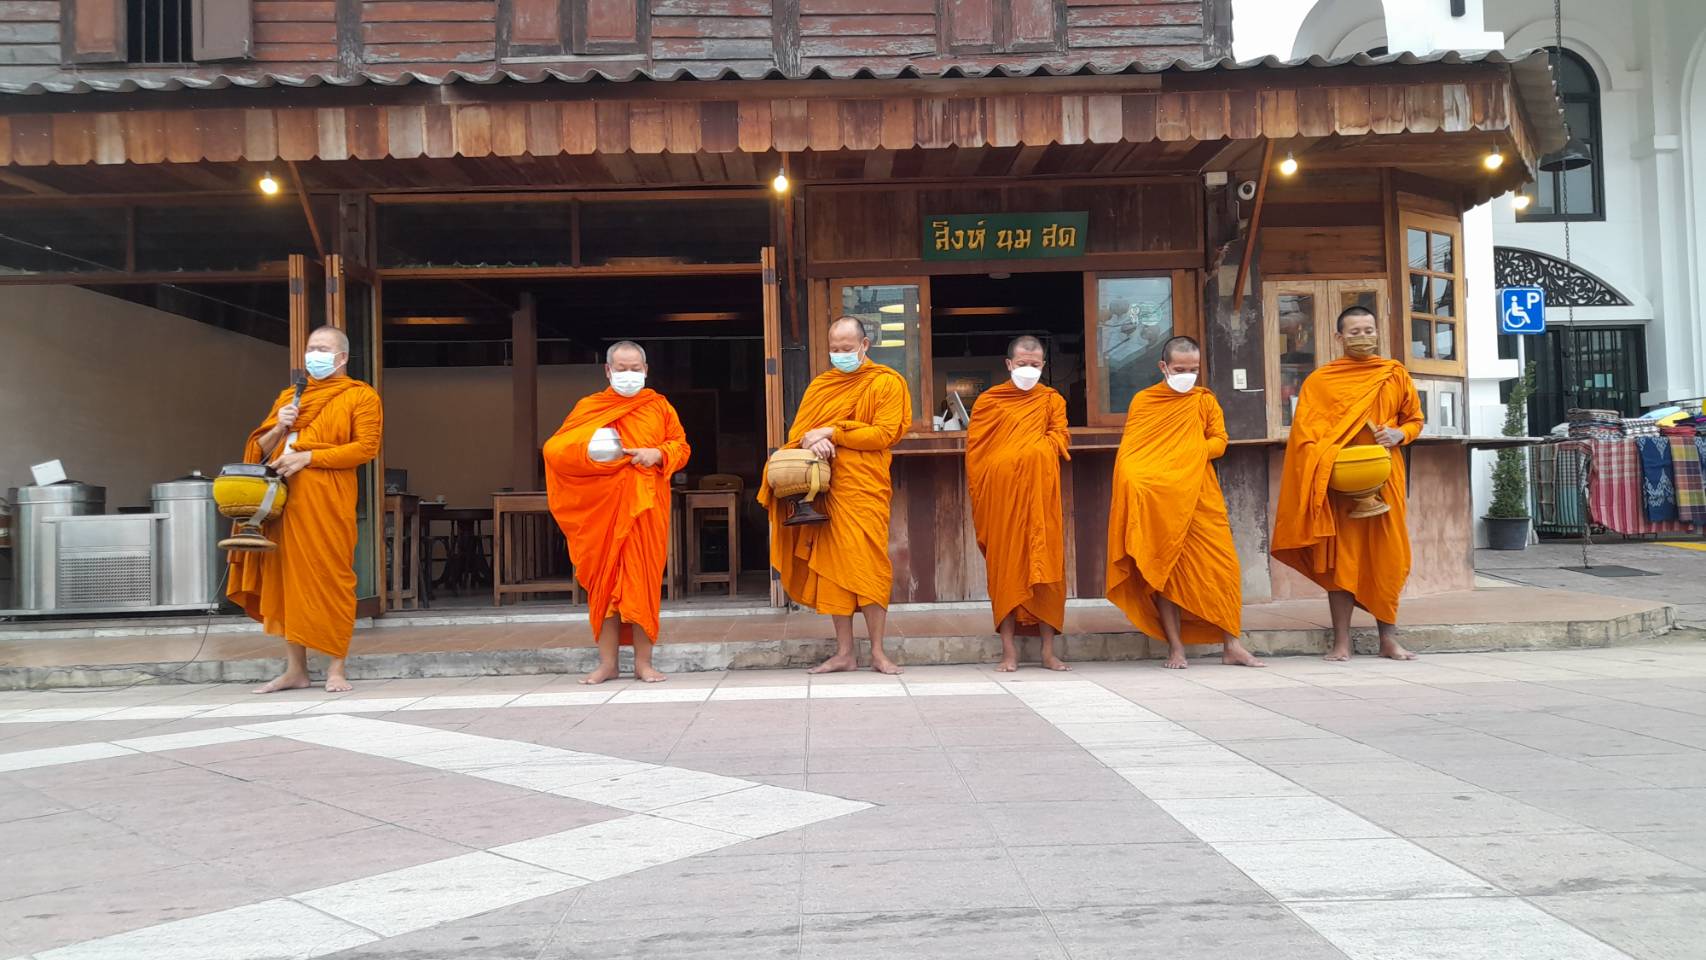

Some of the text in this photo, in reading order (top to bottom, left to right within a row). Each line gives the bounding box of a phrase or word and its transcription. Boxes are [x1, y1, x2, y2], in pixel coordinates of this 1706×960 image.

[933, 220, 1077, 253] สิงห์ นม สด
[1527, 292, 1540, 309] P
